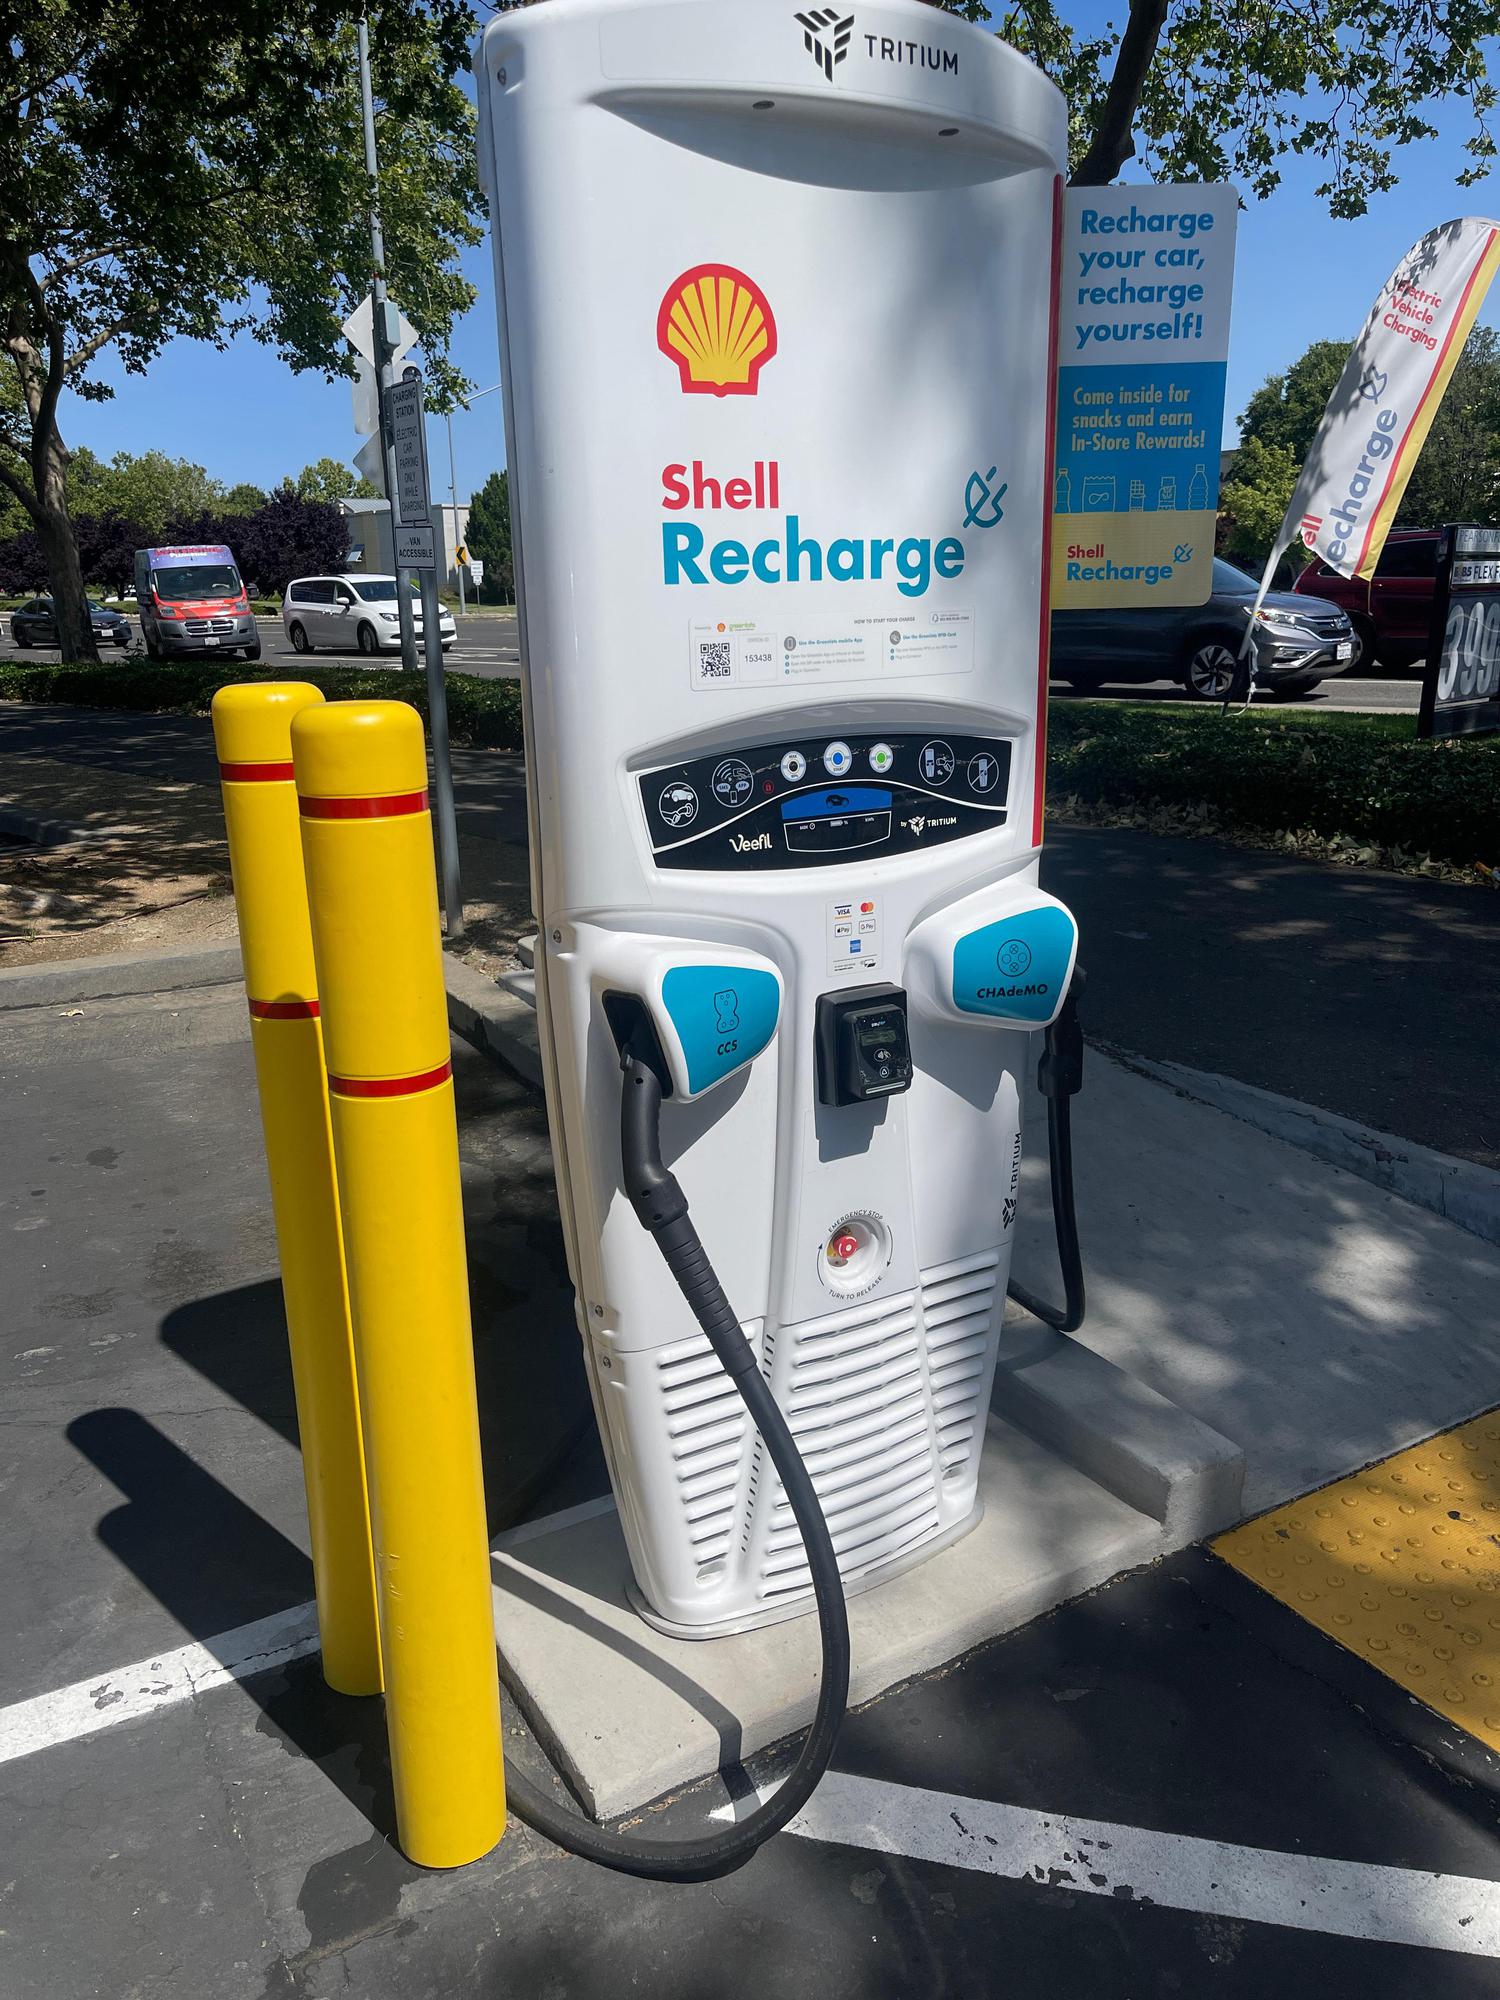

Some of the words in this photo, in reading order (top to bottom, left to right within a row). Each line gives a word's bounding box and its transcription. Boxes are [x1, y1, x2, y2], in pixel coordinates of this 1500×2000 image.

[864, 34, 958, 75] TRITIUM
[1081, 206, 1214, 239] Recharge
[1078, 250, 1146, 277] your
[1154, 248, 1205, 270] car,
[1078, 277, 1204, 309] recharge
[1397, 280, 1442, 308] Electric
[1392, 295, 1433, 324] Vehicle
[1076, 312, 1203, 350] yourself!
[1383, 313, 1438, 351] Charging
[393, 387, 416, 404] CHARGING
[1073, 386, 1114, 405] Come
[1119, 383, 1162, 404] inside
[1168, 383, 1191, 403] for
[396, 404, 415, 418] STATION
[1072, 409, 1121, 428] snacks
[1127, 407, 1153, 427] and
[1159, 412, 1193, 426] earn
[396, 426, 418, 440] ELECTRIC
[1071, 432, 1130, 451] In-Store
[1135, 430, 1206, 450] Rewards!
[403, 442, 413, 454] CAR
[399, 456, 419, 468] PARKING
[404, 473, 416, 483] ONLY
[661, 460, 779, 511] Shell
[1326, 409, 1398, 562] echarge
[404, 486, 418, 497] WHILE
[402, 500, 425, 513] CHARGING
[1301, 513, 1323, 546] ell
[409, 537, 421, 546] VAN
[1067, 544, 1105, 559] Shell
[399, 549, 433, 558] ACCESSIBLE
[662, 515, 965, 598] Recharge
[1067, 560, 1173, 585] Recharge
[1473, 565, 1493, 579] FLEX
[745, 653, 772, 663] 153438
[900, 820, 907, 828] by
[926, 817, 957, 827] TRITIUM
[729, 833, 773, 852] Veefil
[976, 983, 1048, 999] CHAdeMO
[717, 1039, 738, 1056] CCS
[1010, 1132, 1022, 1192] TRITIUM
[828, 1209, 867, 1233] EMERGENCY
[867, 1210, 884, 1220] STOP
[828, 1289, 844, 1300] TURN
[856, 1275, 883, 1298] RELEASE
